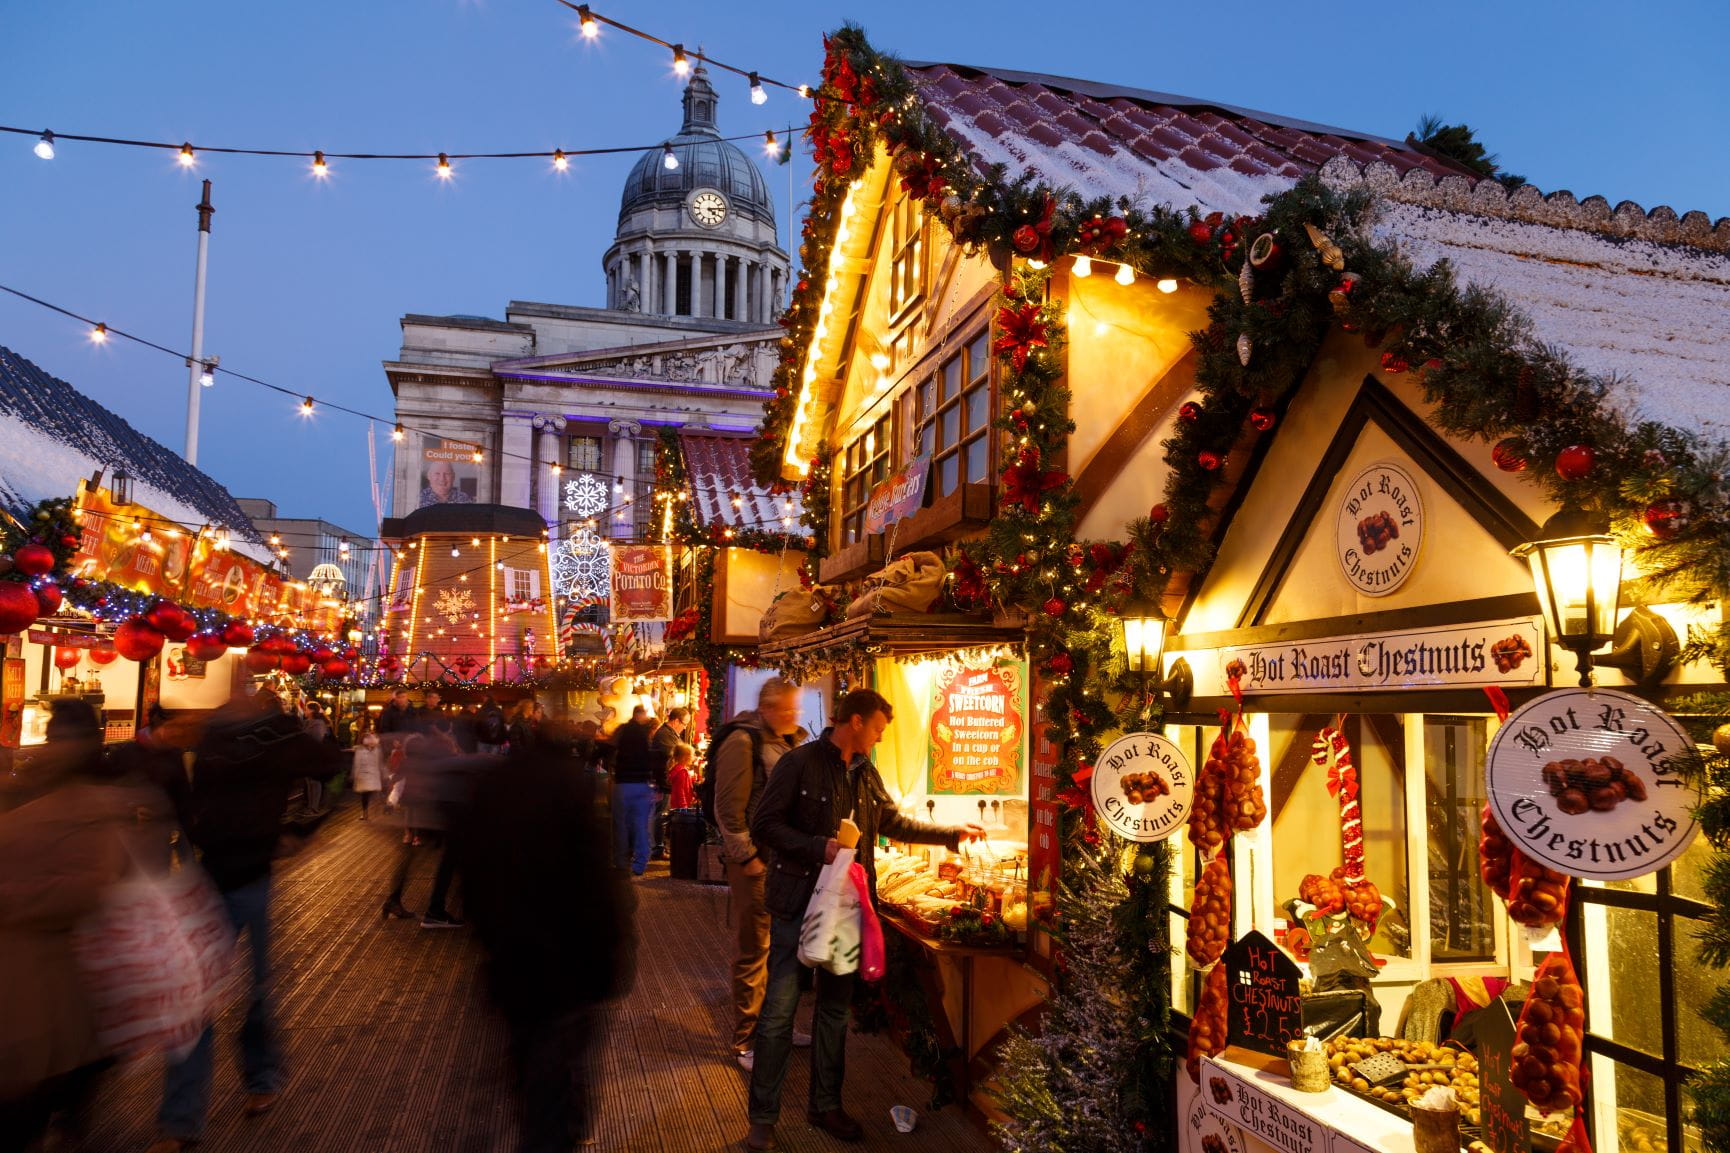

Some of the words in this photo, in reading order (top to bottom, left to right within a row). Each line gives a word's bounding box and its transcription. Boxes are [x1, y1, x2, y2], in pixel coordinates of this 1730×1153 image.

[426, 450, 453, 458] Could
[1345, 479, 1374, 521] Hot
[1377, 473, 1415, 528] Roast
[623, 560, 660, 574] VICTORIAN
[633, 553, 645, 563] THE
[1344, 543, 1413, 586] Chestnuts
[614, 572, 652, 591] POTATO
[1248, 650, 1285, 688] Hot
[1290, 647, 1352, 682] Roast
[1357, 637, 1487, 686] Chestnuts
[949, 694, 1005, 715] SWEETCORN
[949, 716, 965, 726] Hot
[967, 716, 1005, 727] Buttered
[954, 729, 999, 740] Sweetcorn
[964, 744, 970, 752] a
[972, 743, 989, 754] cup
[990, 743, 1001, 753] or
[1513, 706, 1584, 758] Hot
[1591, 703, 1687, 788] Roast
[953, 756, 964, 765] on
[967, 755, 981, 765] the
[983, 756, 999, 766] cob
[1105, 742, 1141, 773] Hot
[1144, 741, 1187, 788] Roast
[1103, 795, 1185, 833] Chestnuts
[1511, 797, 1678, 864] Chestnuts
[1233, 982, 1301, 1014] CHESTNUTS
[1236, 1083, 1263, 1114] Hot
[1265, 1100, 1313, 1143] Roast
